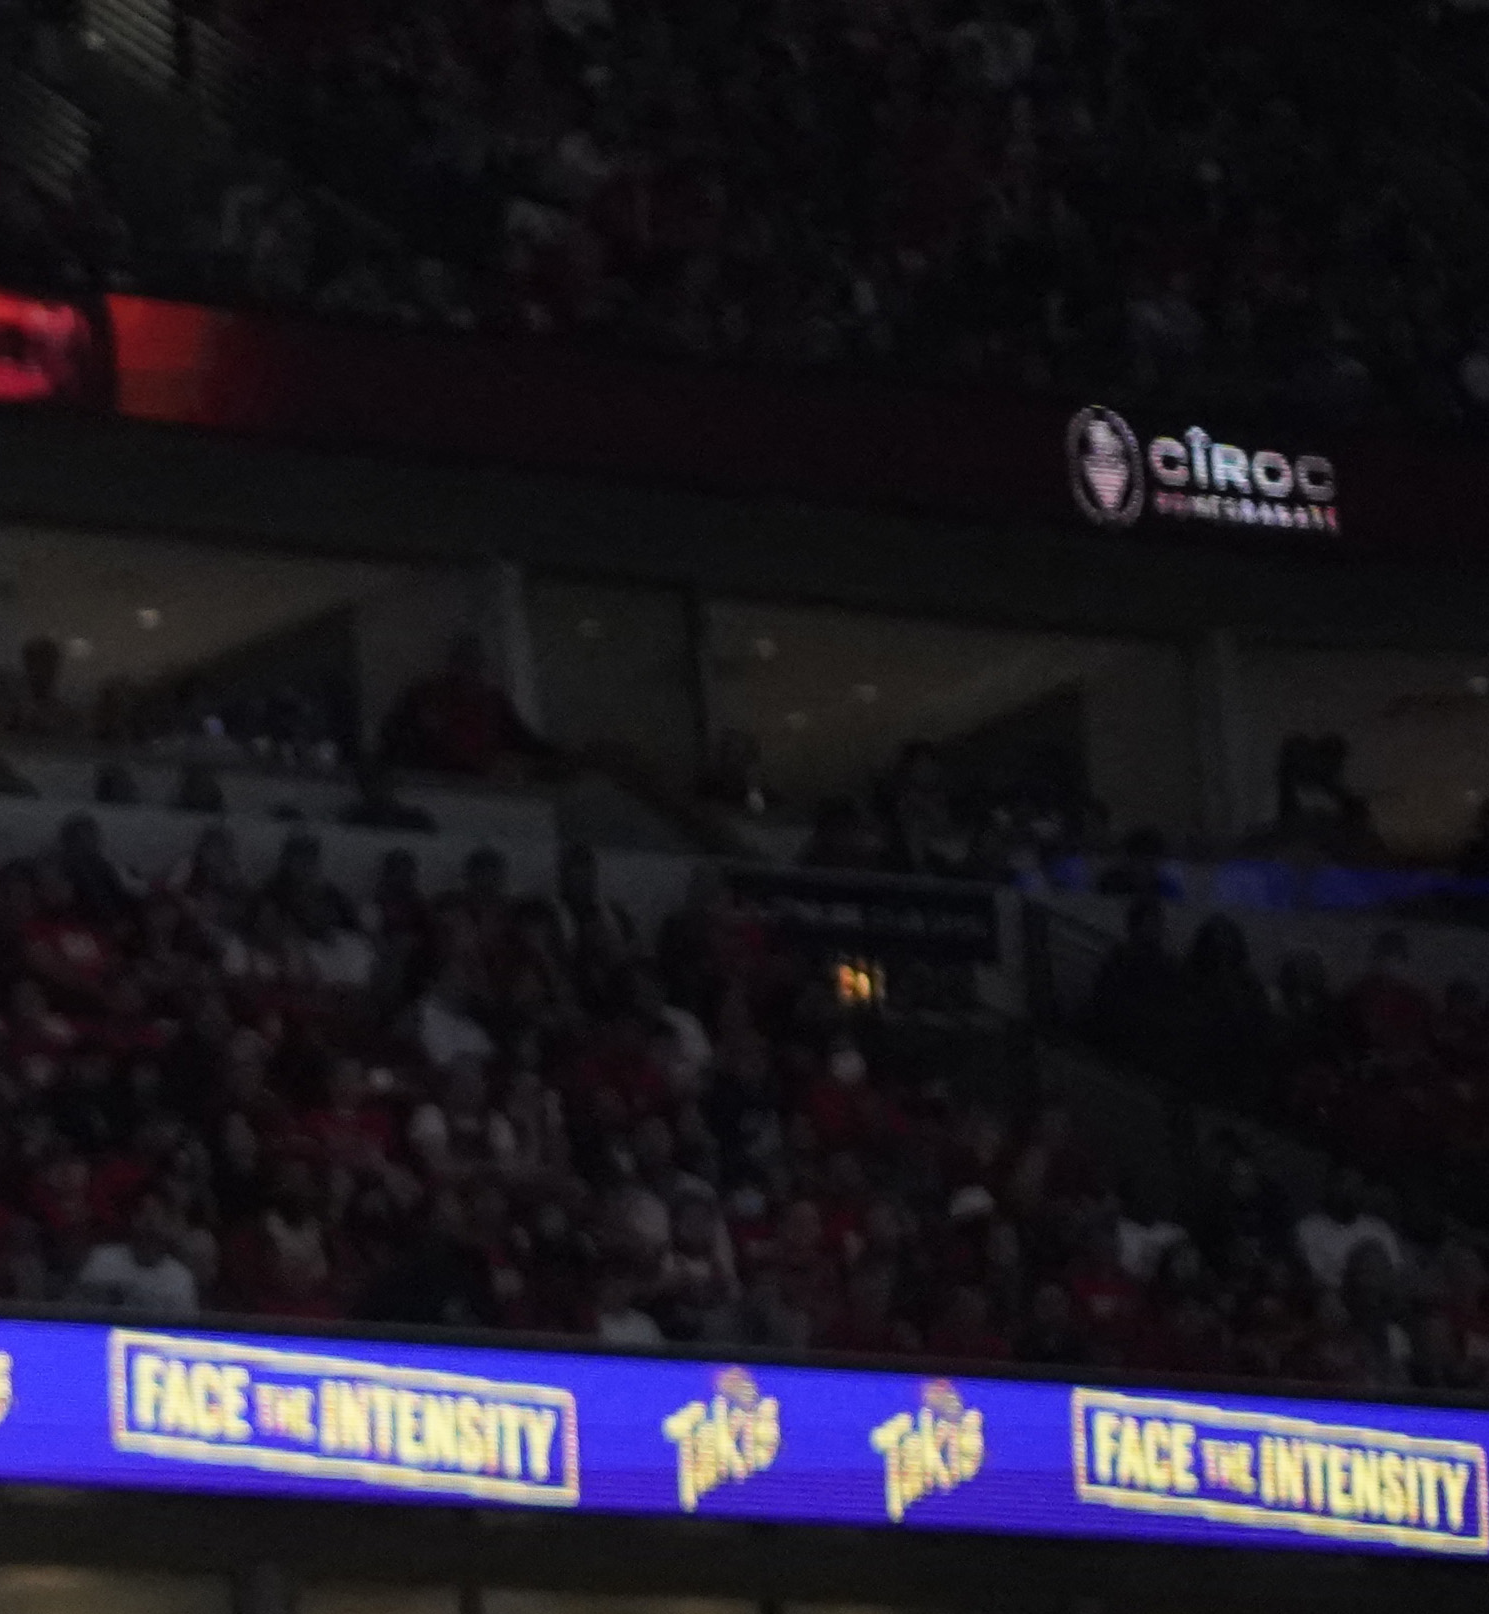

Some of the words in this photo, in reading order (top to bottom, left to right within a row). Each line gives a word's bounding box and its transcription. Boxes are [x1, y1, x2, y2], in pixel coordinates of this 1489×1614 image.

[131, 1353, 253, 1441] FACE
[255, 1383, 316, 1442] THE
[318, 1378, 558, 1482] INTENSITY
[1091, 1411, 1199, 1494] FACE
[1200, 1437, 1257, 1493] THE
[1258, 1434, 1471, 1533] INTENSITY
